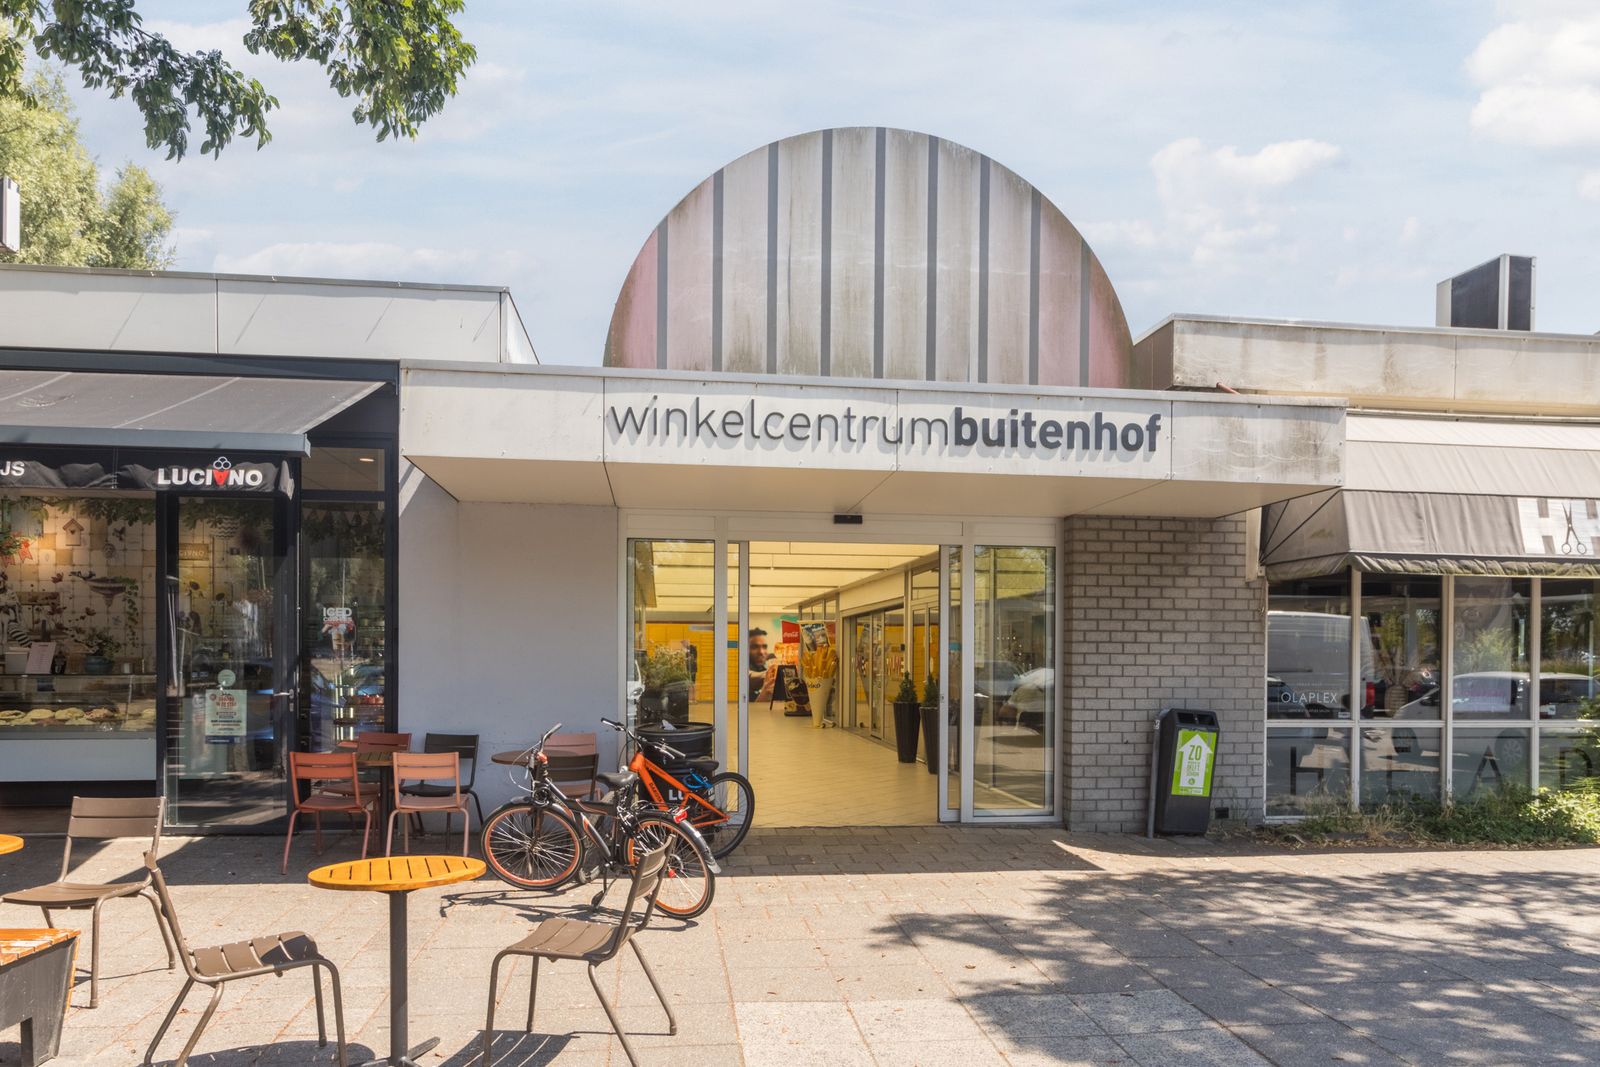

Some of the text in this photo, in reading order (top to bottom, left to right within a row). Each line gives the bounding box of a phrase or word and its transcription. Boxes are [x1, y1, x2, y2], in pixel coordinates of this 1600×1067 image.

[157, 467, 263, 486] LUCIANO
[323, 607, 353, 617] ICED
[1281, 692, 1338, 704] OLAPLEX
